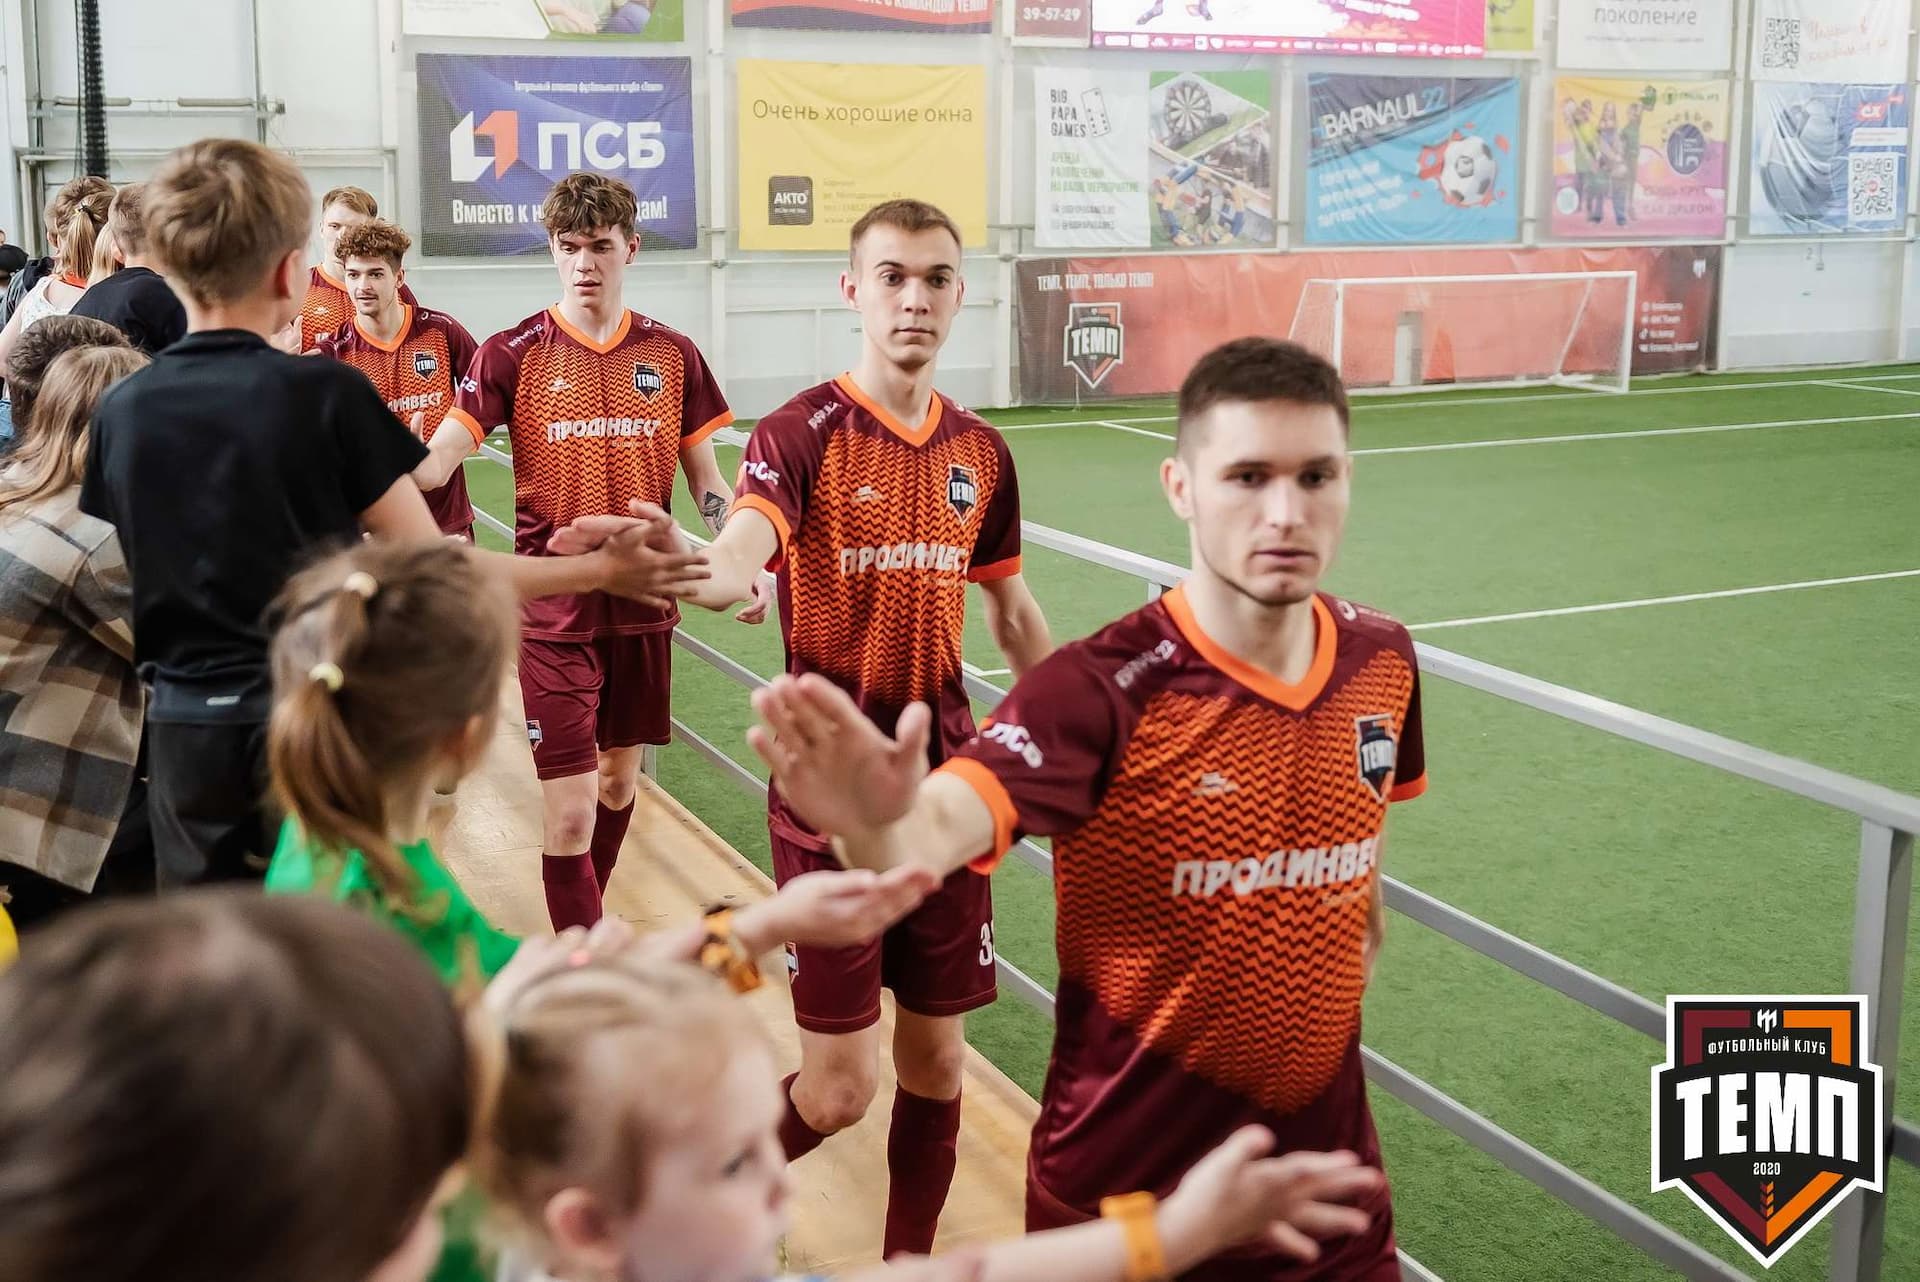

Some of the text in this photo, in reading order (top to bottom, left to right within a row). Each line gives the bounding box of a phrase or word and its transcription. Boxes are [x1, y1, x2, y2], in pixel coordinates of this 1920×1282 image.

[1023, 7, 1081, 21] 39-57-29
[1594, 7, 1697, 25] поколение
[1050, 89, 1068, 103] BIG
[752, 99, 973, 125] Очень хорошие окна
[1051, 106, 1078, 121] PAPA
[1051, 122, 1086, 138] GAMES
[537, 121, 666, 170] ПСБ
[773, 192, 808, 205] АКТО
[452, 199, 514, 224] Вместе
[517, 204, 529, 223] к
[1071, 326, 1119, 357] ТЕМП
[415, 359, 437, 371] ТЕМП
[636, 373, 660, 390] ТЕМП
[387, 391, 444, 412] ИНВЕСТ
[979, 921, 994, 966] 3
